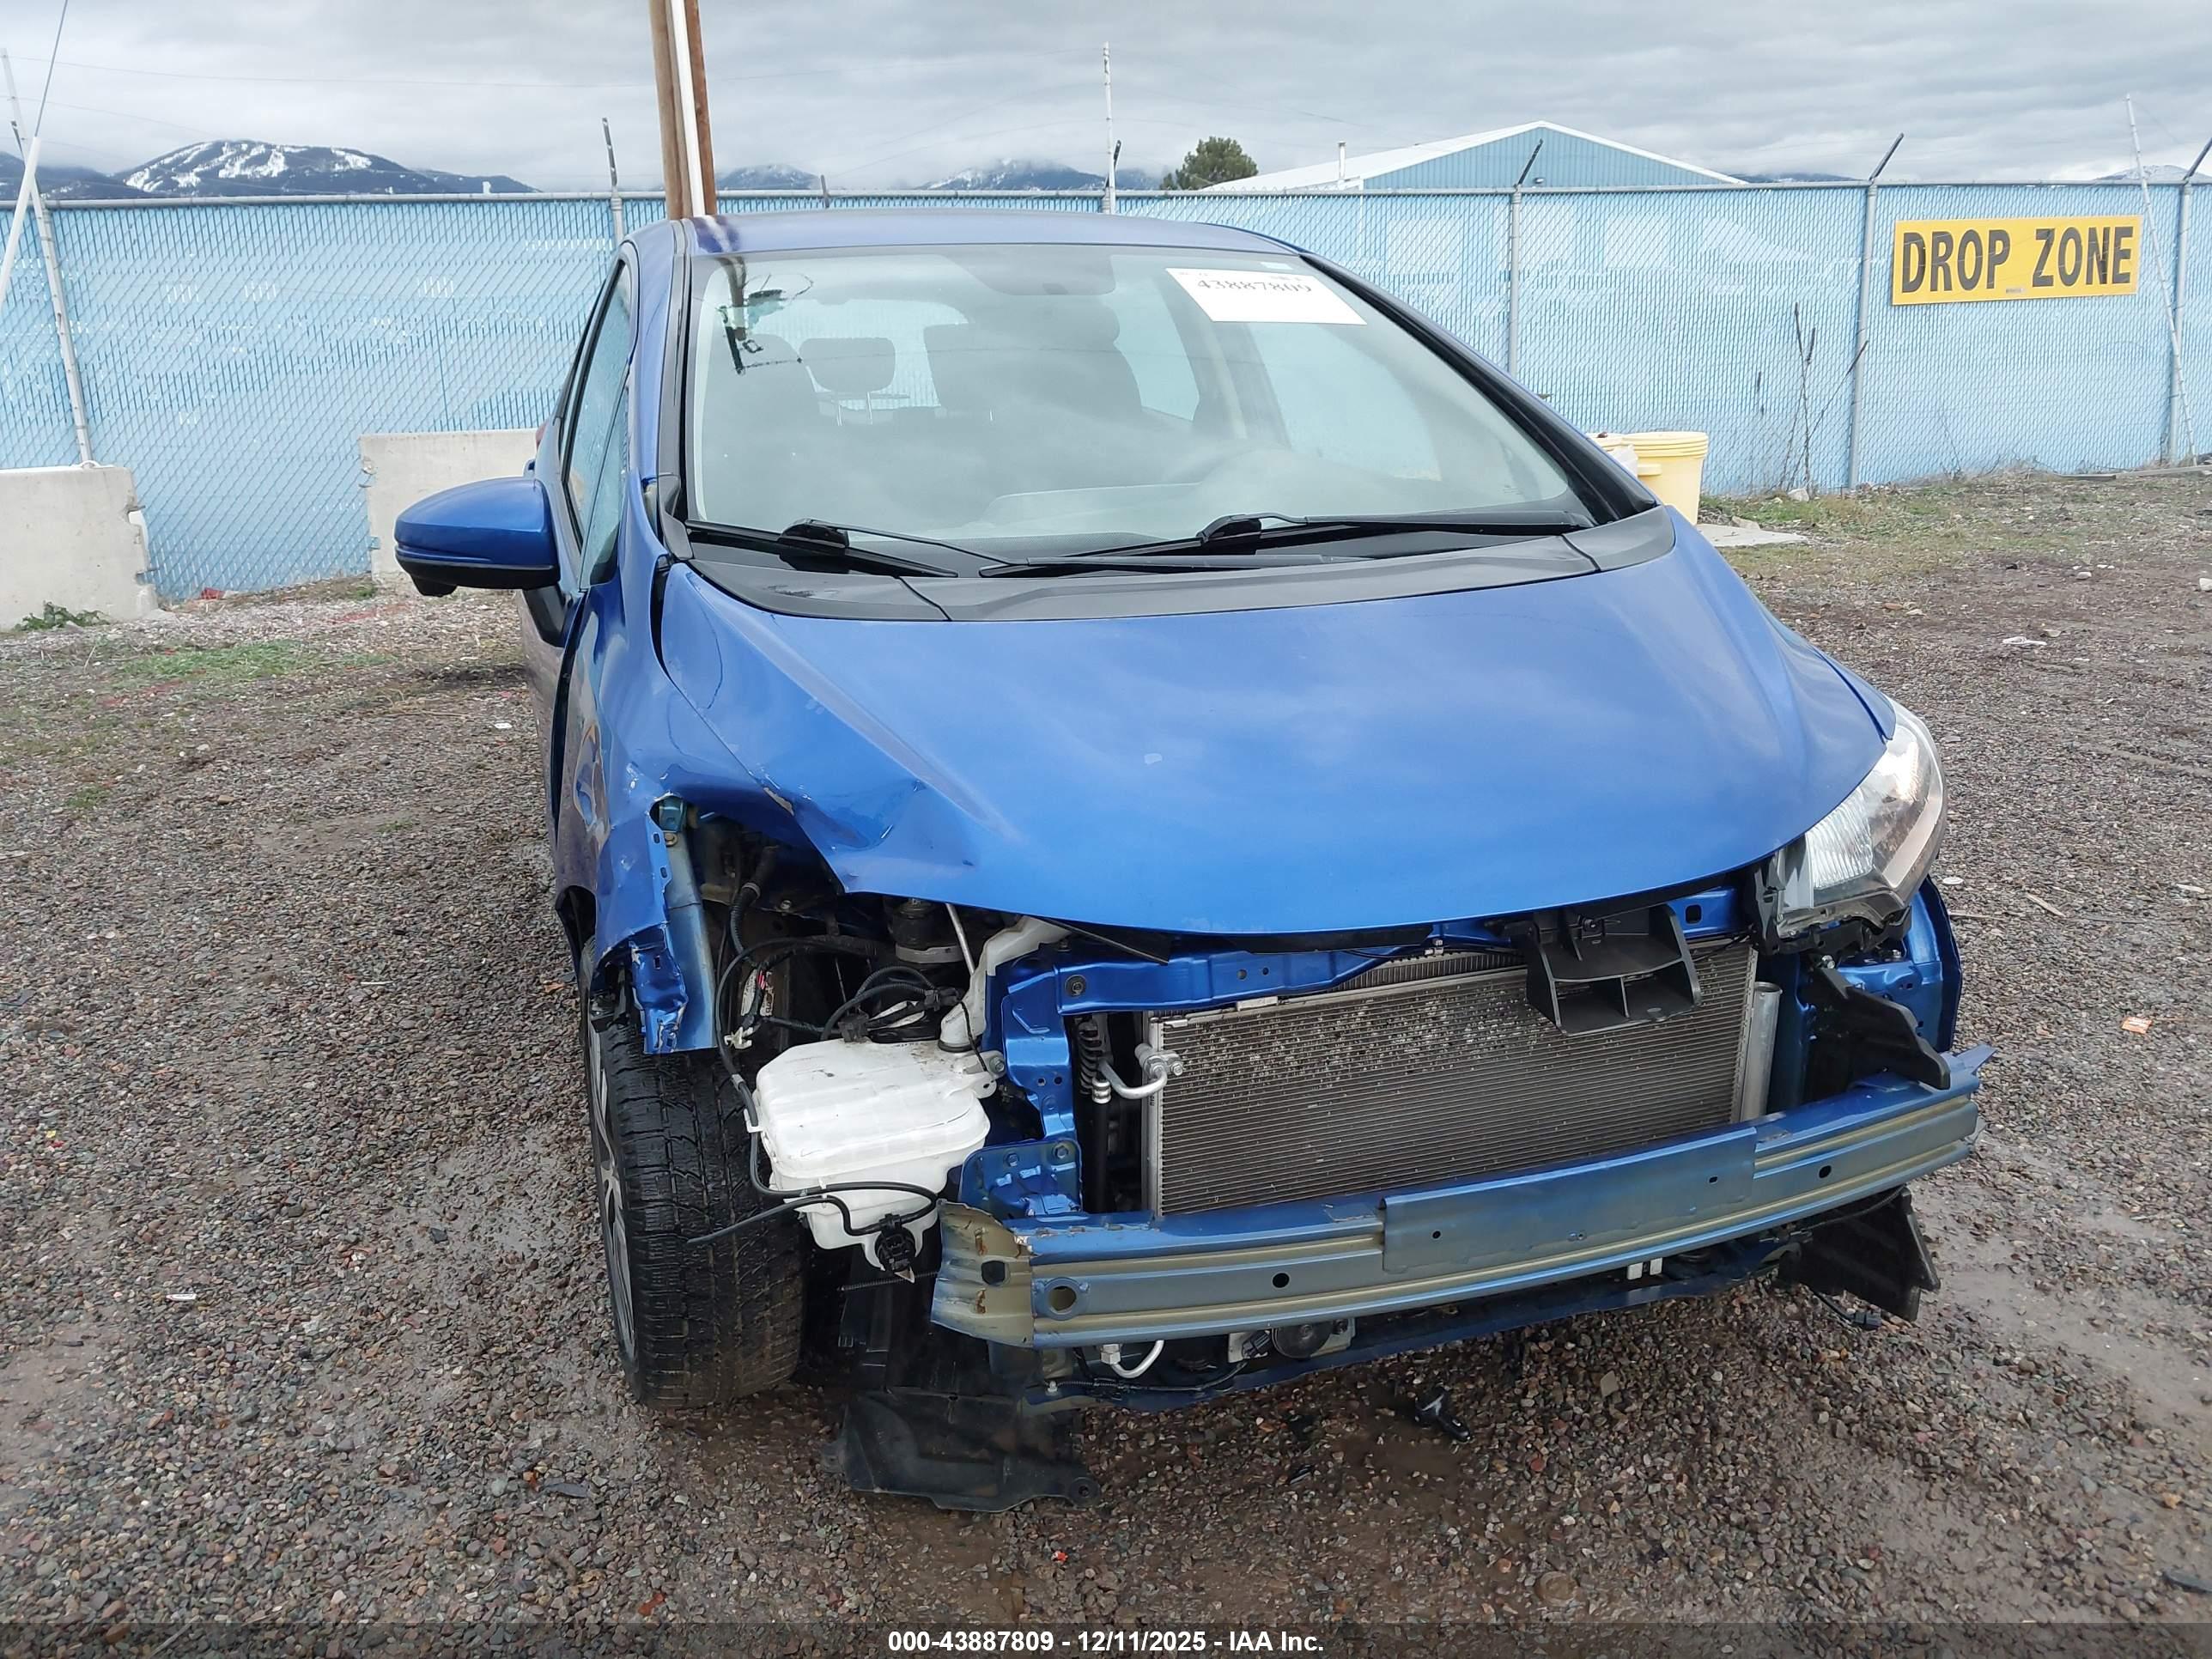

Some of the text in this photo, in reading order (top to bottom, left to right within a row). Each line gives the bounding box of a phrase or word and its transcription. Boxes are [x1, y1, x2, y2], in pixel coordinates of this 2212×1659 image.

[1901, 226, 2134, 293] DROP ZONE
[1197, 280, 1312, 292] 43887809
